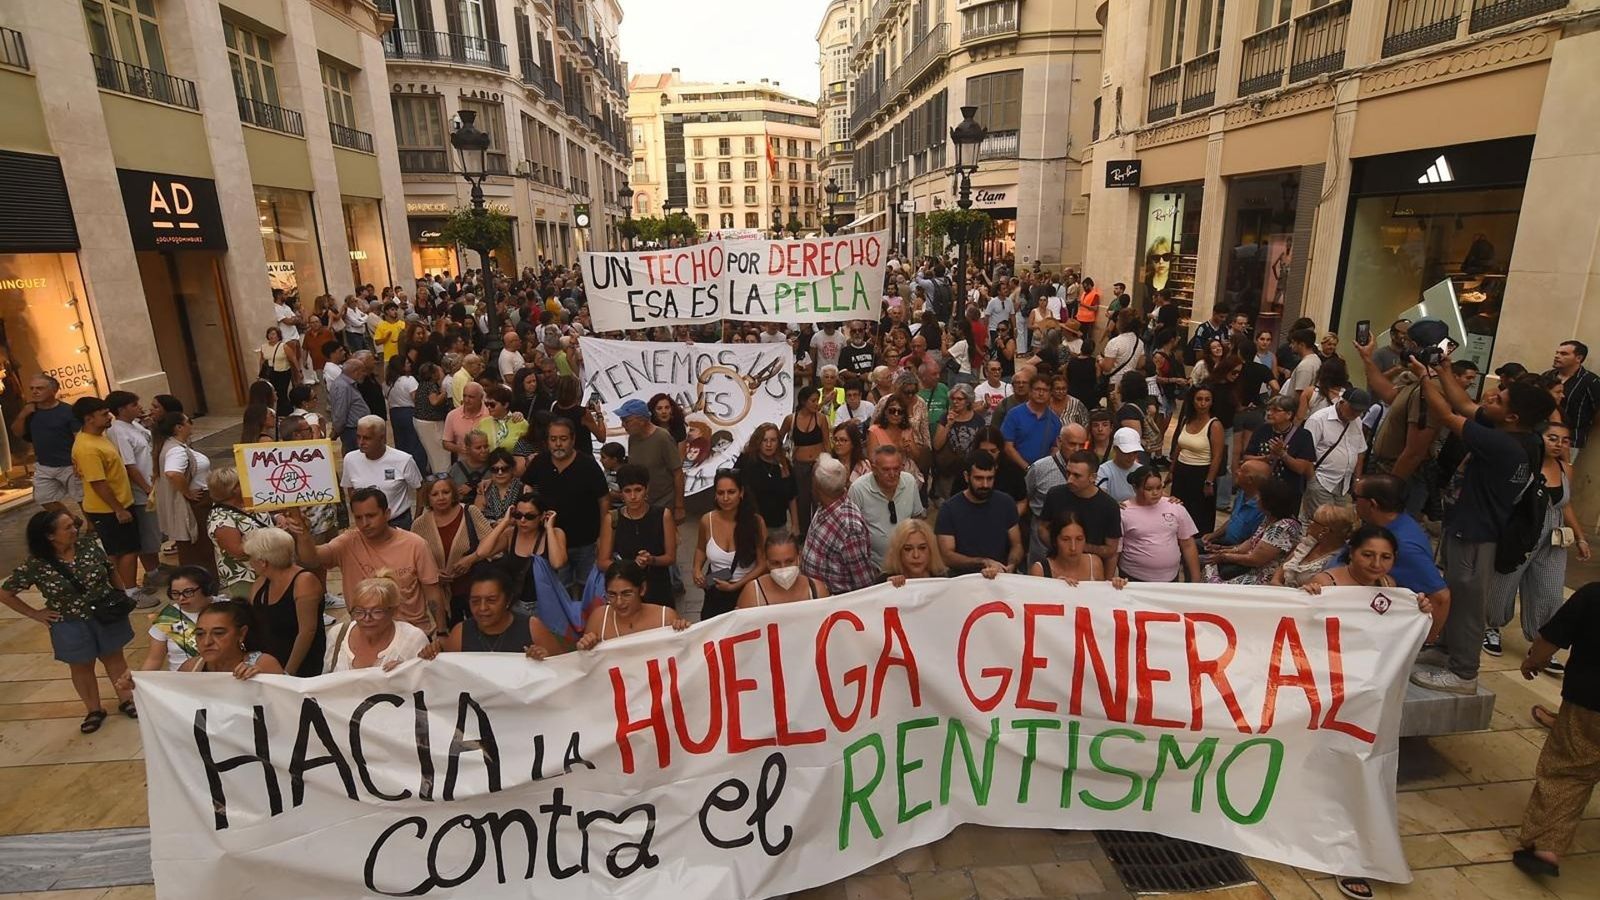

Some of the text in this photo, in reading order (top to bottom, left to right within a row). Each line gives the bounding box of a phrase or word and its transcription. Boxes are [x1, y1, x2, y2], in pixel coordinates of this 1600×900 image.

[393, 83, 441, 94] OTEL
[150, 180, 194, 215] AD
[975, 189, 1006, 202] Etam
[591, 236, 881, 290] UN TECHO POR DERECHO
[628, 271, 871, 323] ESA ES LA PELEA
[585, 350, 739, 404] TENEMOS
[251, 448, 325, 468] MÁLAGA
[295, 488, 334, 504] AMOS
[193, 601, 1377, 831] HACIA LA HUELGA GENERAL
[364, 716, 1285, 897] contra el RENTISMO
